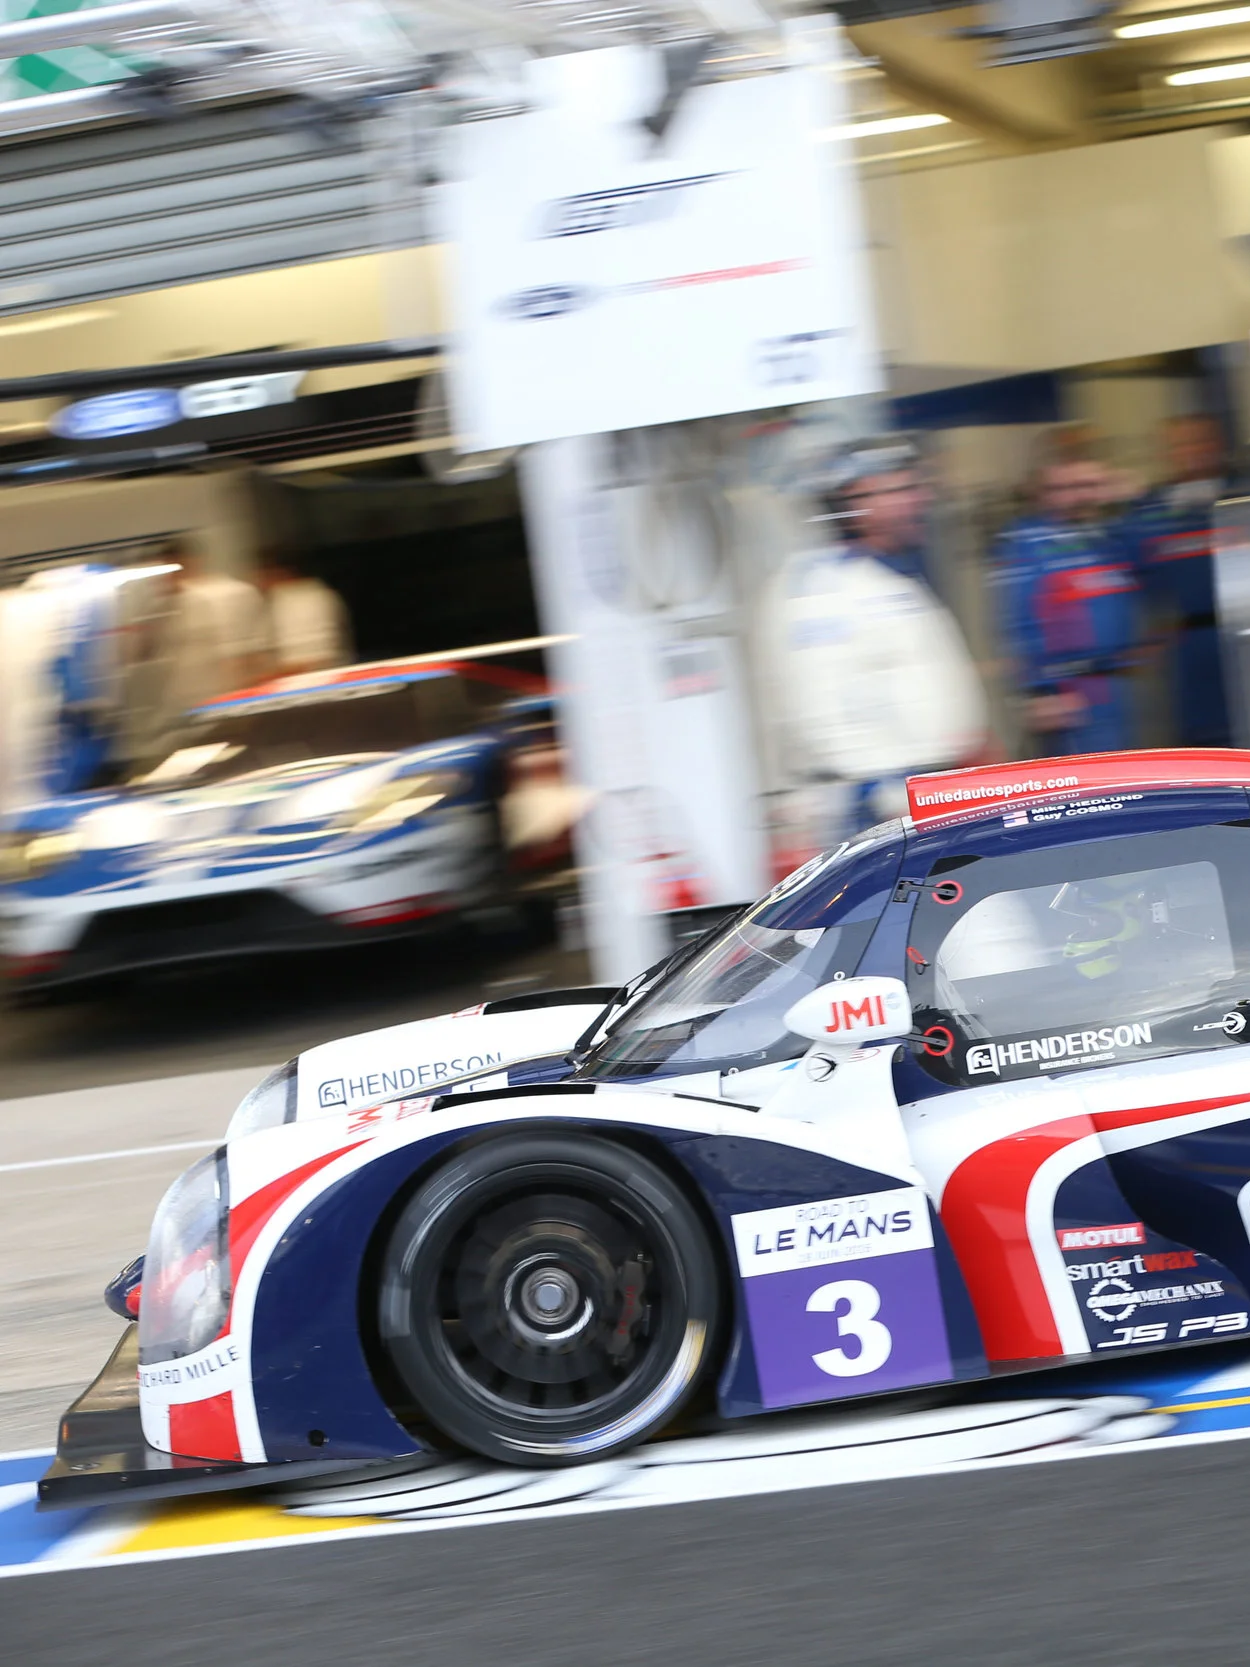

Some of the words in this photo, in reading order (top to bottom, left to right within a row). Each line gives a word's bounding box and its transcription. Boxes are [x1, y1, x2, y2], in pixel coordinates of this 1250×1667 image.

[915, 774, 1079, 807] unitedautosports.com
[1031, 803, 1066, 815] Mike
[1068, 794, 1144, 808] HEDLUND
[1032, 810, 1062, 824] Guy
[1064, 803, 1124, 817] COSMO
[824, 995, 887, 1033] JMI
[997, 1022, 1152, 1067] HENDERSON
[349, 1052, 502, 1099] HENDERSON
[795, 1203, 842, 1222] ROAD
[755, 1228, 796, 1256] LE
[807, 1210, 913, 1247] MANS
[1062, 1227, 1142, 1248] MOTUL
[805, 1279, 892, 1378] 3
[1097, 1322, 1169, 1348] JS
[1178, 1312, 1249, 1338] P3
[185, 1345, 240, 1378] MILLE
